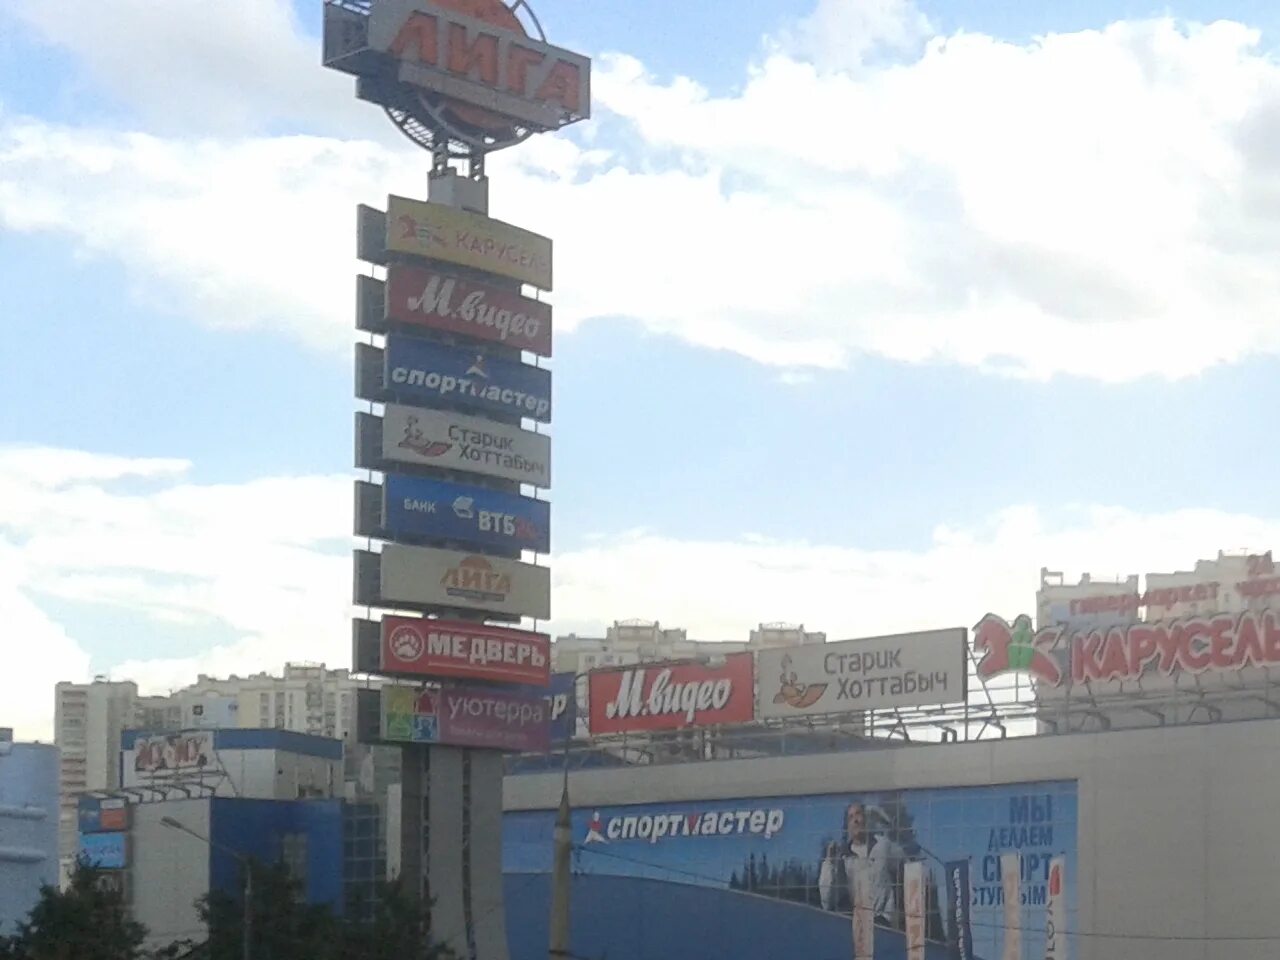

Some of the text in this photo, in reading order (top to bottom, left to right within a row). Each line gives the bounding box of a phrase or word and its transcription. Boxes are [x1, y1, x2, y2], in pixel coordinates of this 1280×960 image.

[386, 9, 581, 113] ЛИГА
[448, 424, 515, 450] Старик
[404, 498, 437, 513] БАНК
[427, 632, 545, 667] МЕДВЕРЬ
[824, 648, 901, 676] Старик
[606, 668, 732, 725] М.видео
[836, 668, 947, 701] Хоттабыч
[1009, 795, 1053, 824] МЫ
[987, 825, 1054, 852] ДЕЛАЕМ
